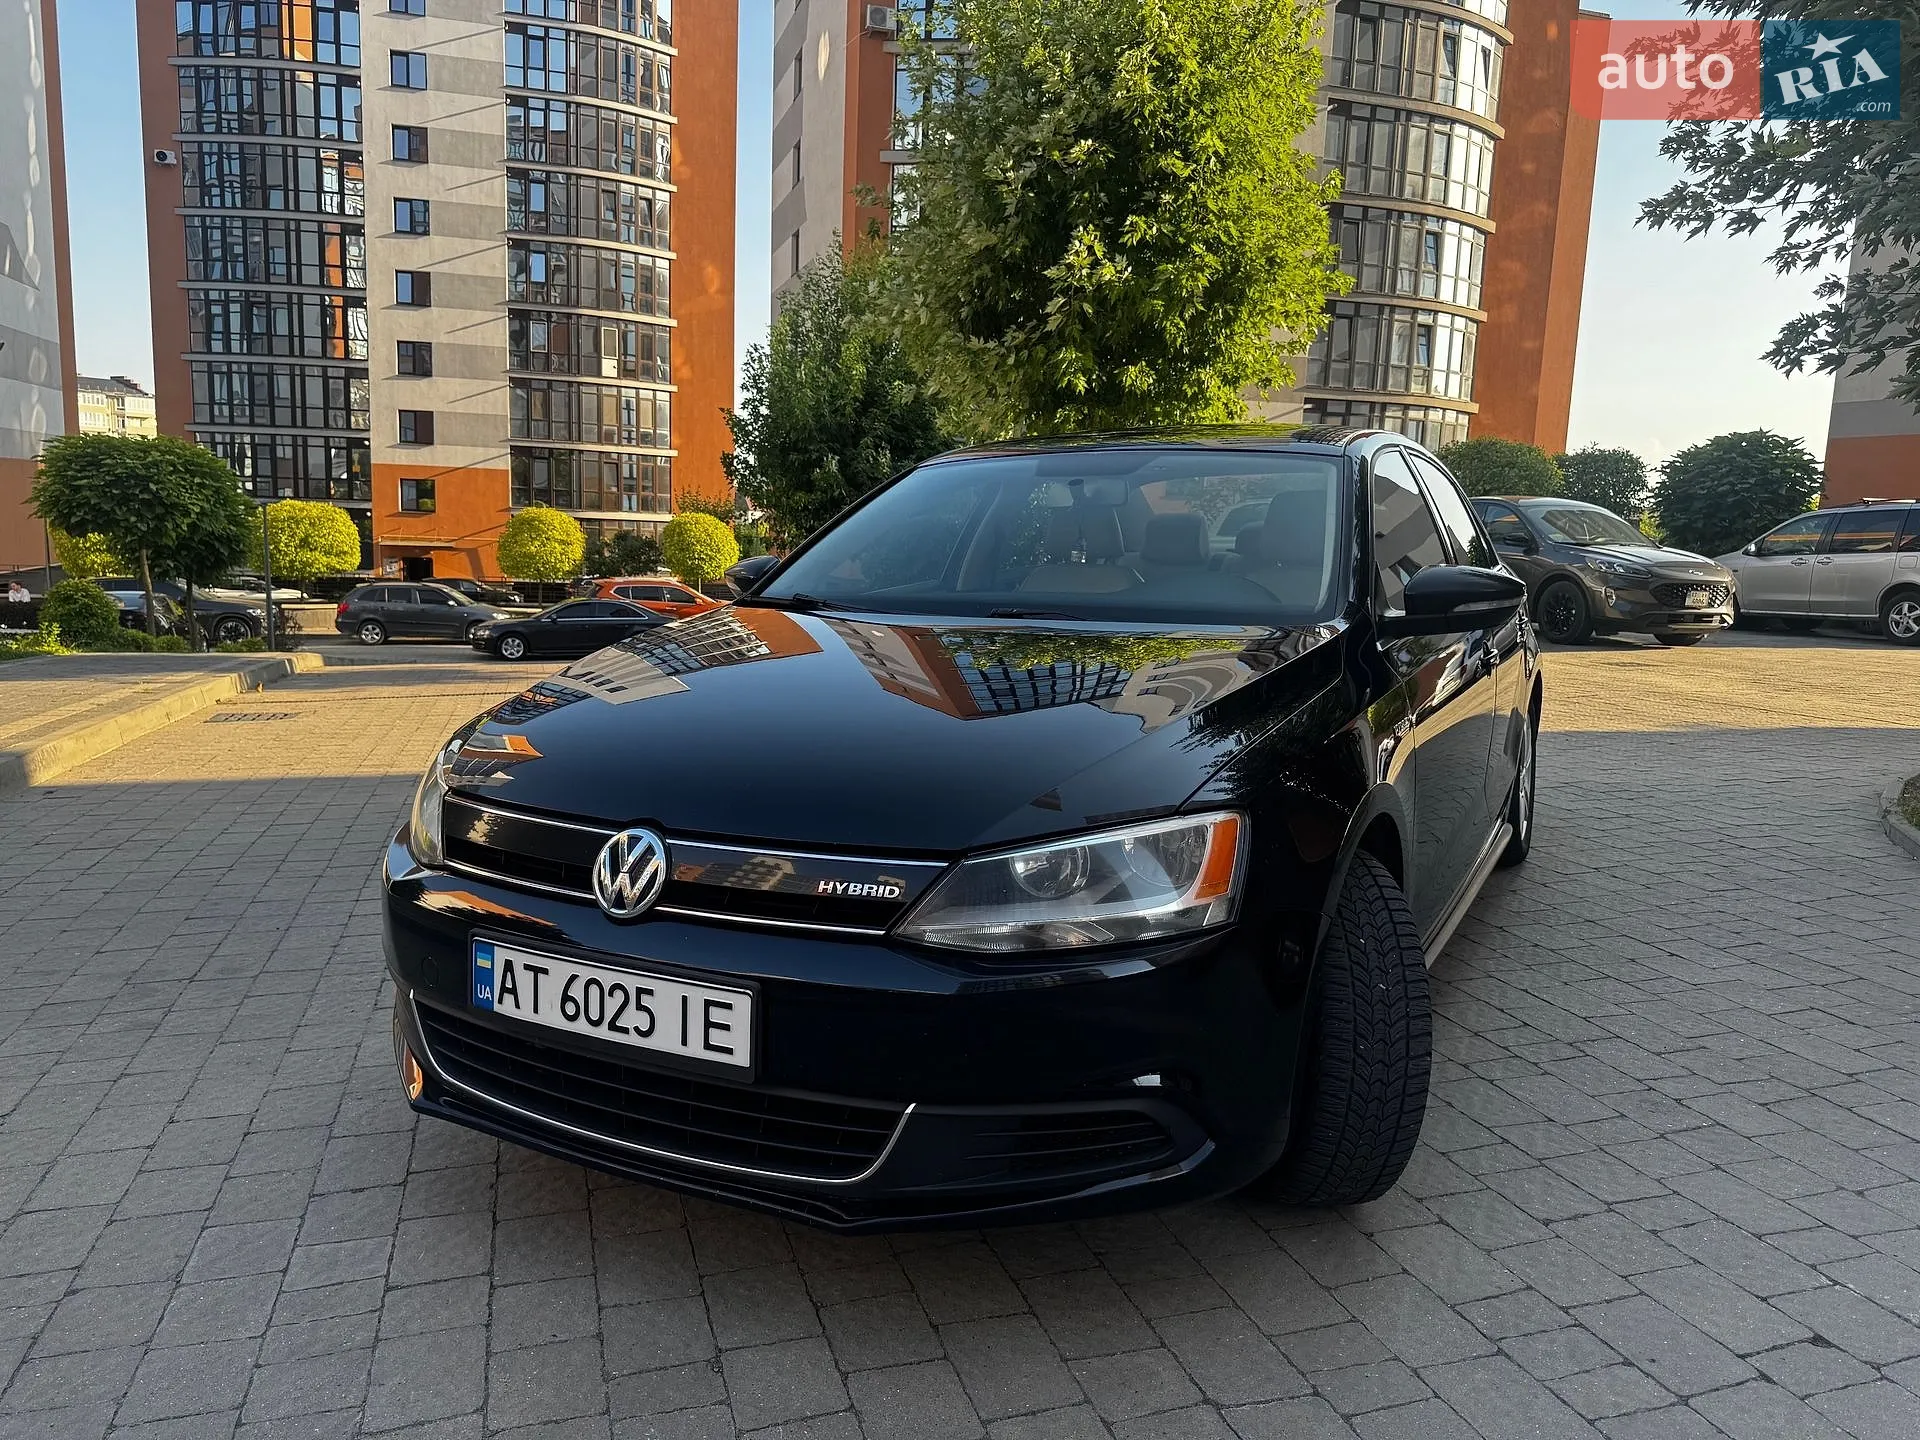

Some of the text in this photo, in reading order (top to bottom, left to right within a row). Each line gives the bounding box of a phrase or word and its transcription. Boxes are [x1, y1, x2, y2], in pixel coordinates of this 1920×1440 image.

[817, 880, 901, 899] HYBRID
[477, 984, 492, 1001] UA
[497, 958, 735, 1056] AT 6025 IE
